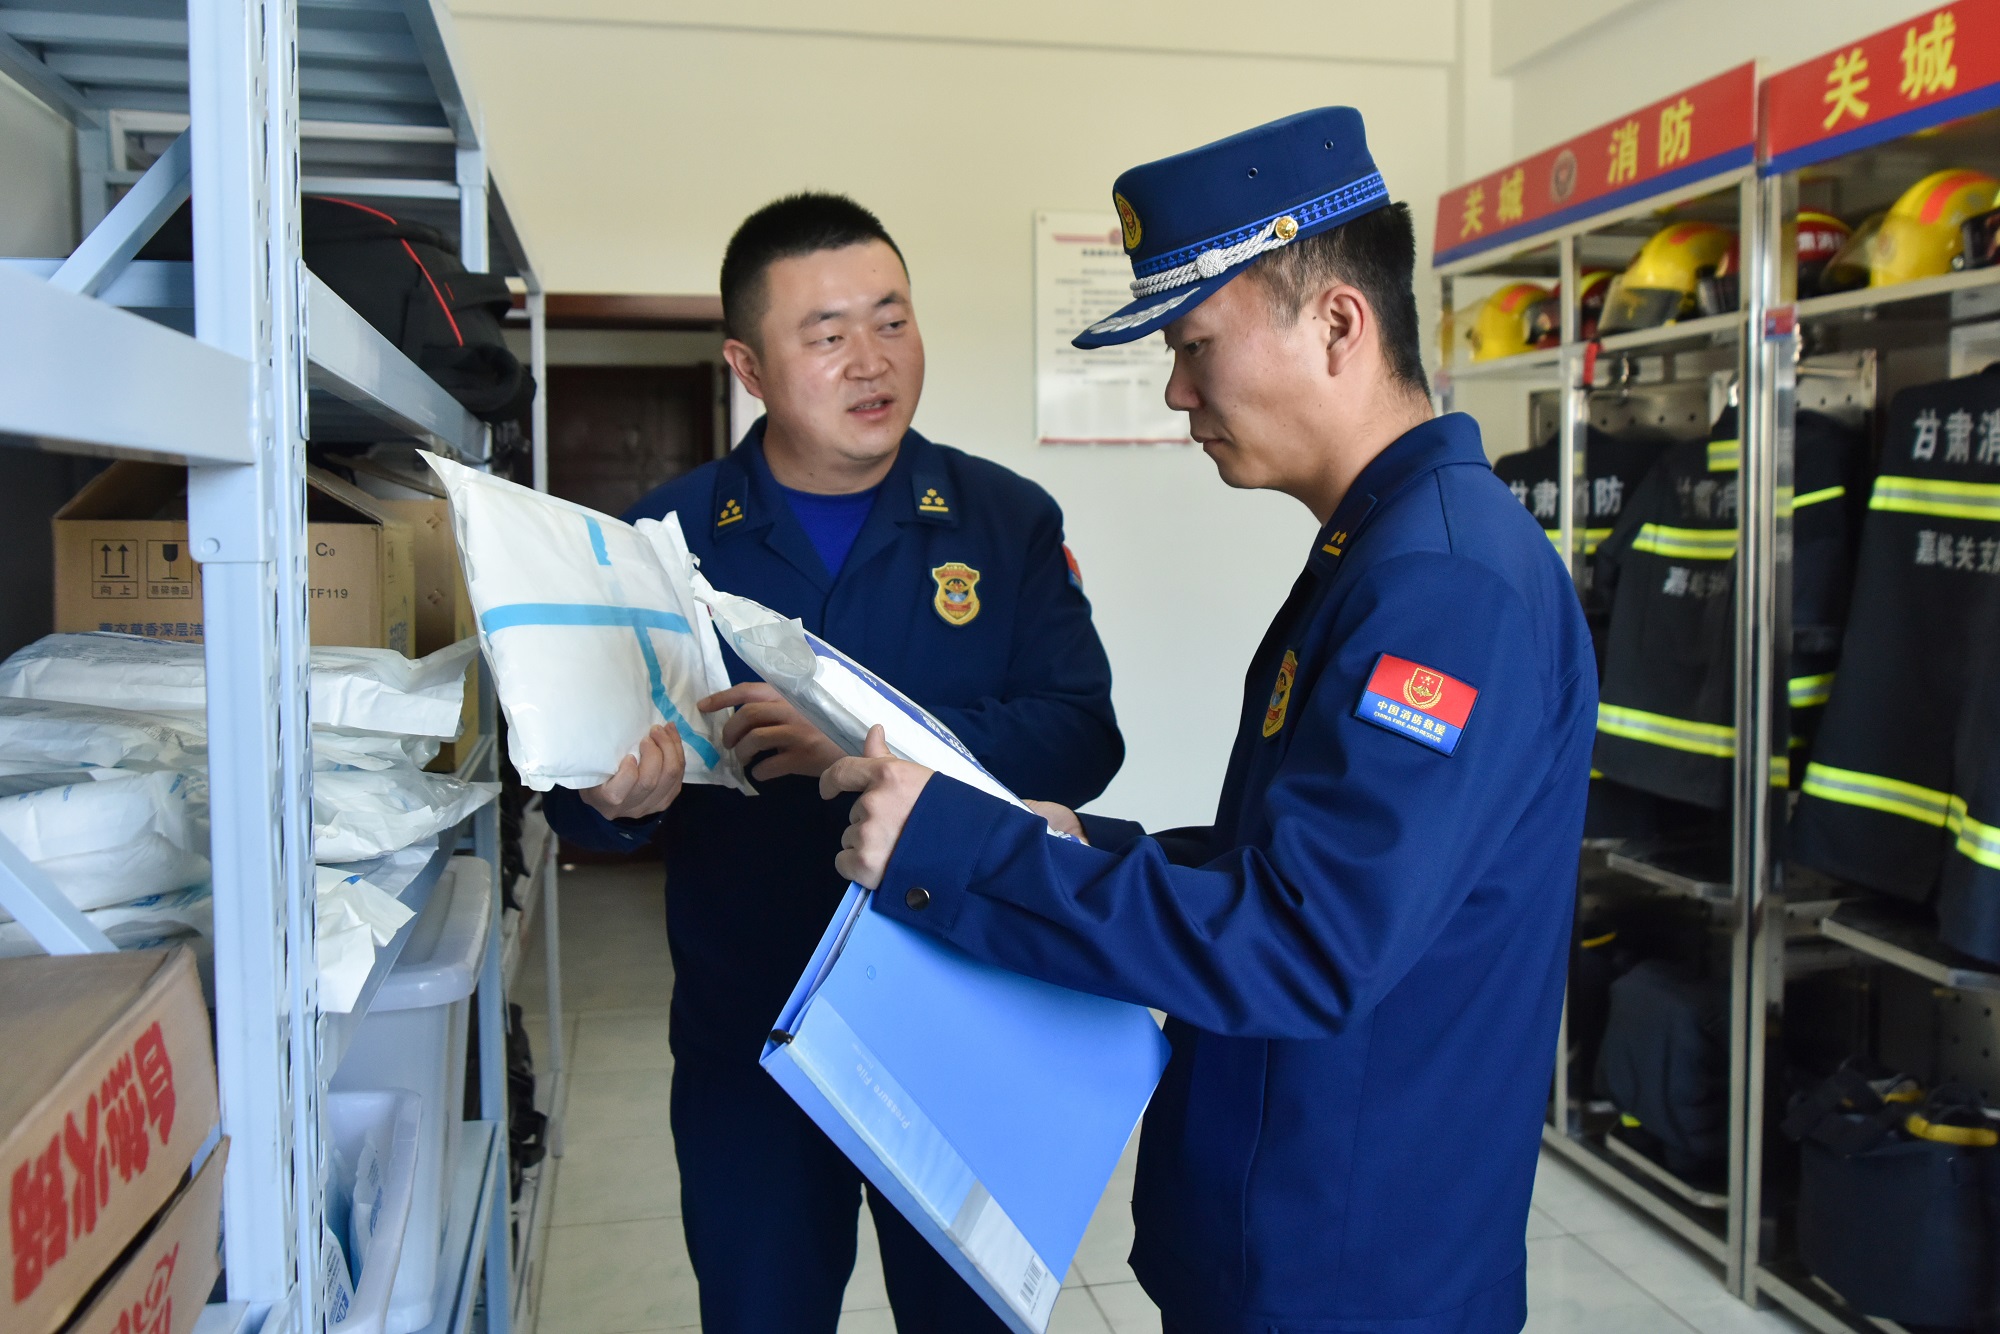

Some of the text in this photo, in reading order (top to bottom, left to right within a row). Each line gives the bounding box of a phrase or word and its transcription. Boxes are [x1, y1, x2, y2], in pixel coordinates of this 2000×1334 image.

[1823, 11, 1957, 130] 关城
[1460, 98, 1694, 238] 关城 消防
[100, 585, 131, 595] 向上
[151, 585, 190, 595] 易碎物品
[1374, 711, 1392, 721] CHINA
[1406, 724, 1420, 733] AND
[1419, 730, 1442, 743] RESCUE
[1377, 700, 1446, 736] 中国消防救援
[857, 1063, 873, 1086] File
[874, 1084, 910, 1129] Pressure
